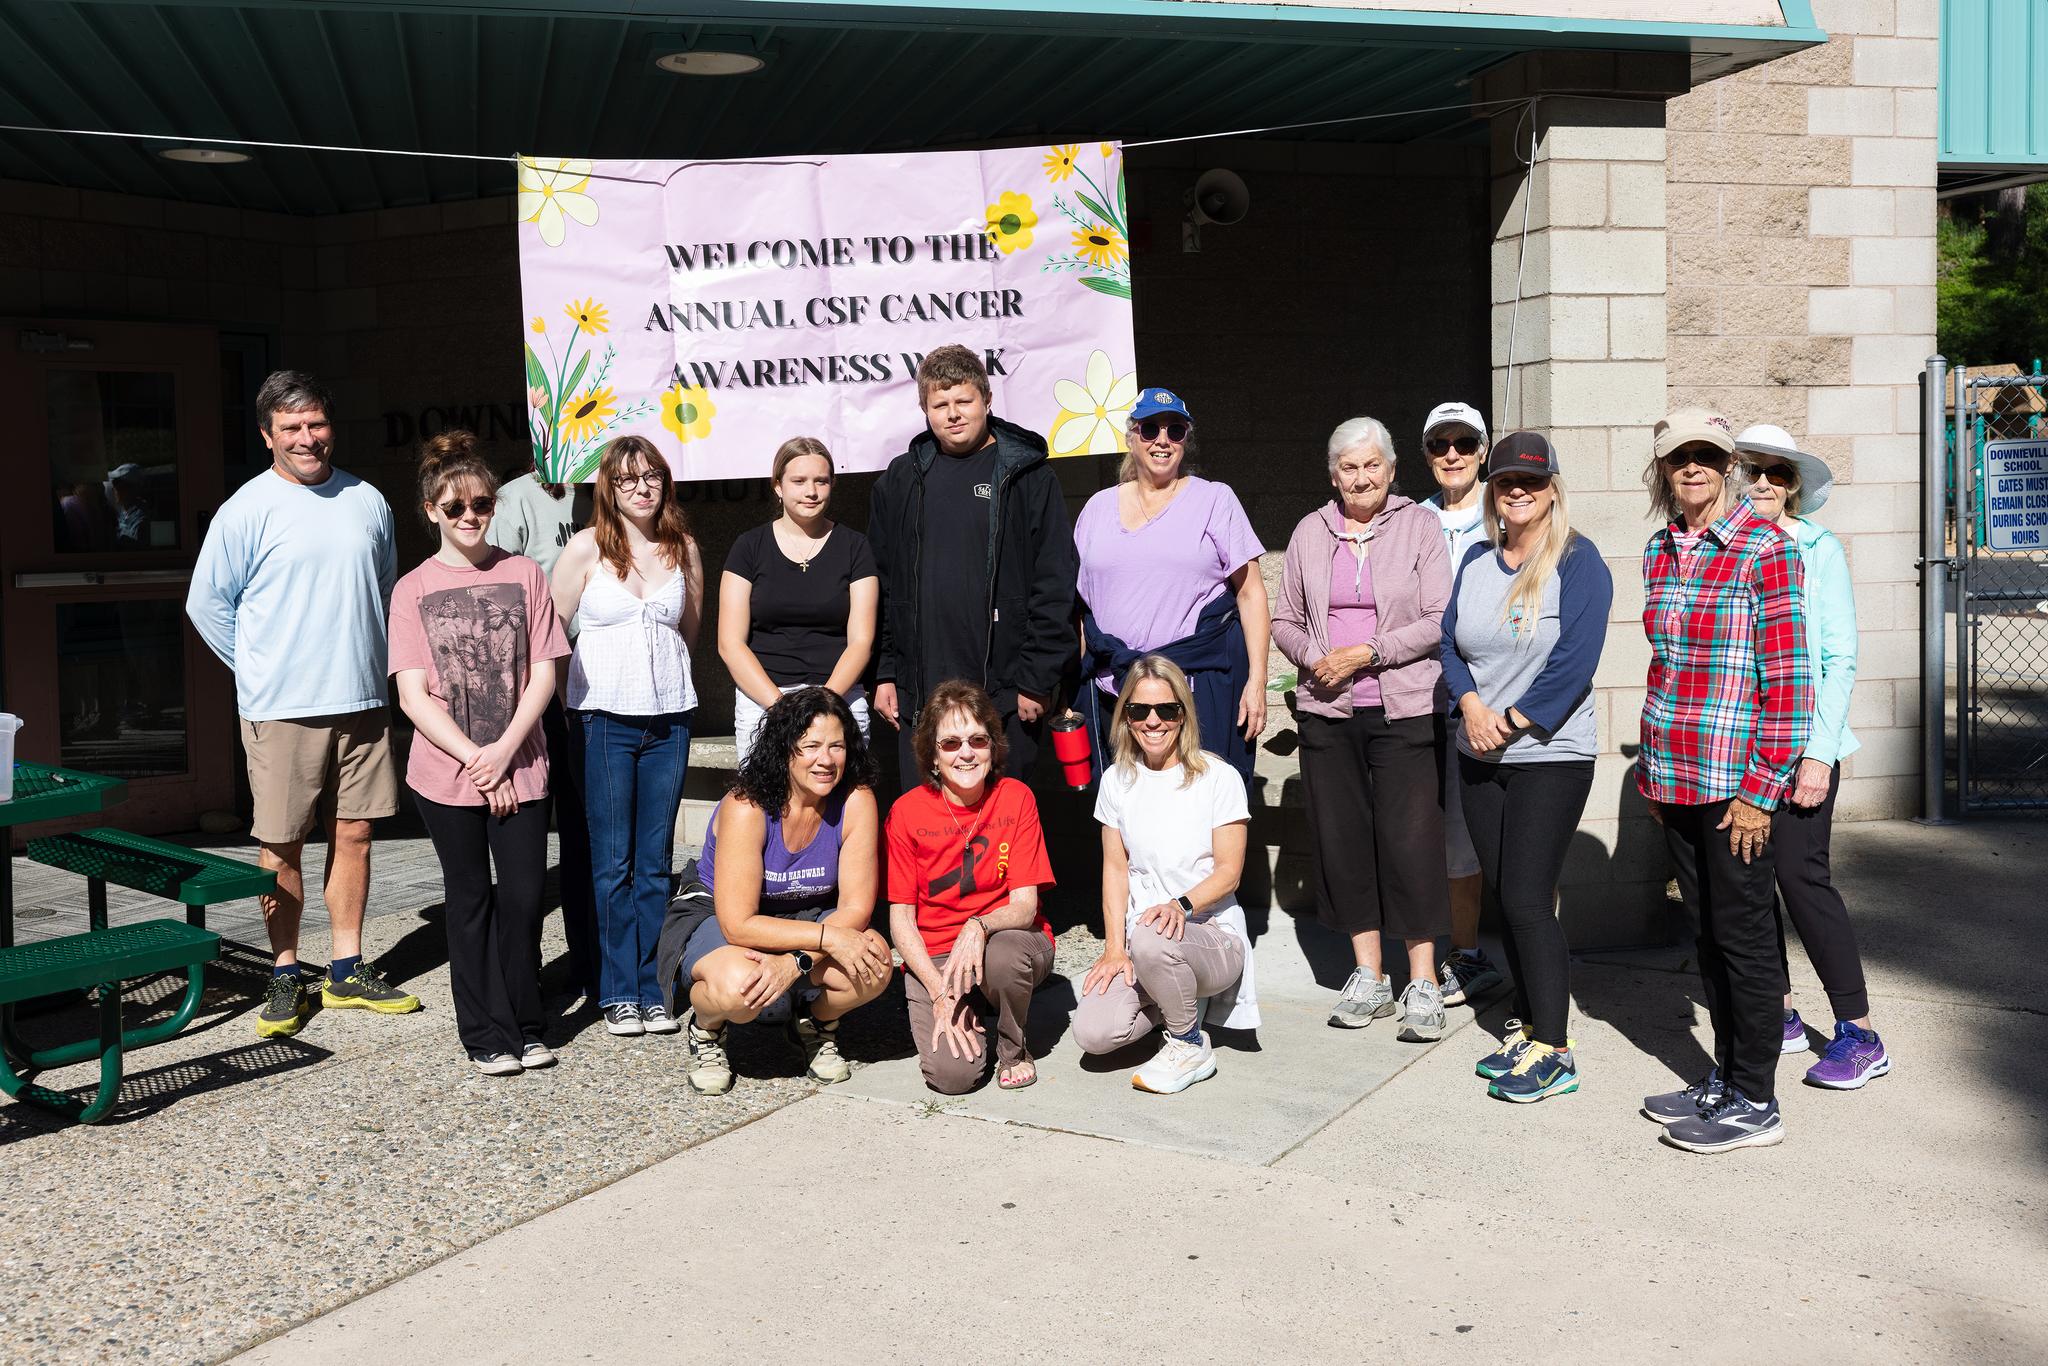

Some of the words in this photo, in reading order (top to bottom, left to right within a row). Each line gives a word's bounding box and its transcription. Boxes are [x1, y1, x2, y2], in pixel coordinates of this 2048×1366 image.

[664, 237, 855, 274] WELCOME
[864, 235, 916, 263] TO
[925, 231, 1000, 262] THE
[645, 299, 801, 332] ANNUAL
[805, 295, 870, 327] CSF
[880, 288, 1025, 323] CANCER
[668, 353, 893, 390] AWARENESS
[900, 347, 1008, 380] WK
[1990, 448, 2048, 460] DOWNIEVILL
[2004, 461, 2042, 472] SCHOOL
[1998, 479, 2023, 493] GATES
[2026, 477, 2048, 492] MUST
[1992, 496, 2023, 510] REMAIN
[2026, 495, 2048, 509] CLOS
[1992, 513, 2023, 528] DURING
[2026, 512, 2048, 526] SCHO
[2011, 529, 2040, 544] HOURS
[788, 866, 826, 881] HARDWARE
